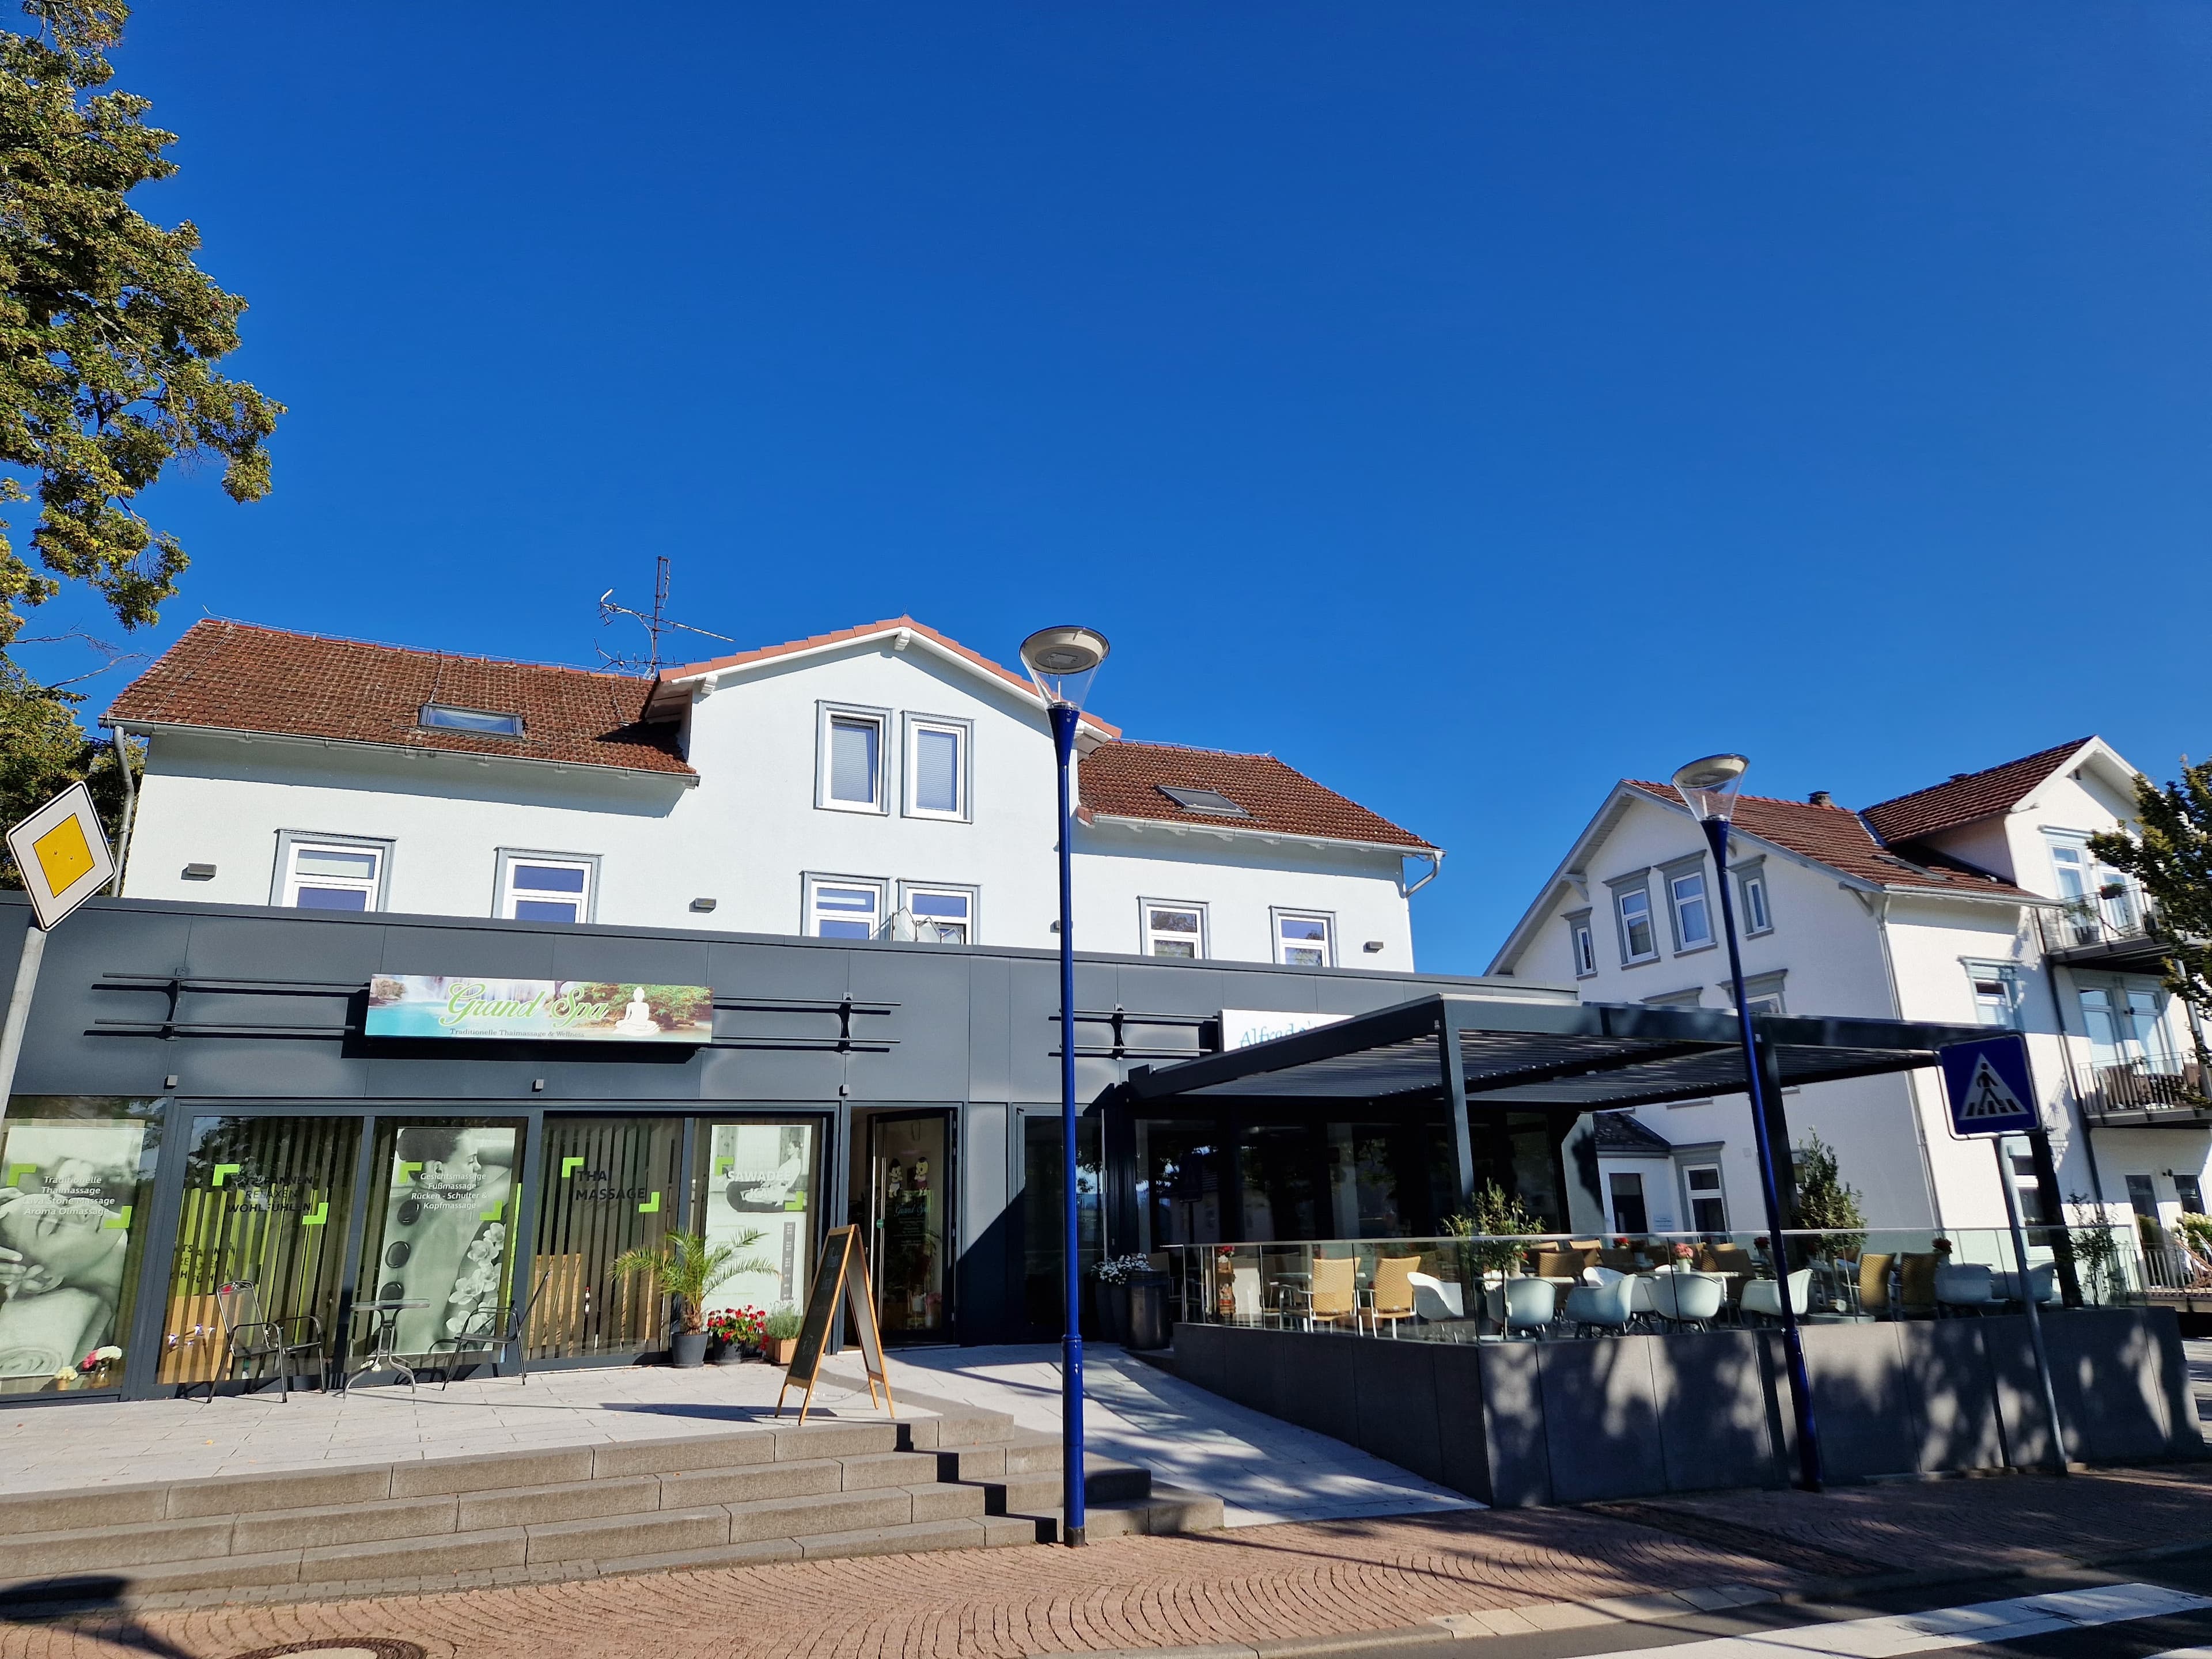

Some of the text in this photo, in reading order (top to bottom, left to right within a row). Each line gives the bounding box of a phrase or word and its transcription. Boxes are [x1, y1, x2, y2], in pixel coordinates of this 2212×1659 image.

[439, 983, 609, 1028] Grand Spa
[499, 1029, 546, 1037] Thaimassage
[421, 1173, 486, 1181] Gesichtsmassage
[728, 1171, 791, 1181] SAWADEE
[42, 1187, 101, 1195] Thaimassage
[428, 1183, 476, 1191] Fußmassage
[576, 1188, 645, 1200] MASSAGE
[423, 1202, 476, 1211] Kopfmassage
